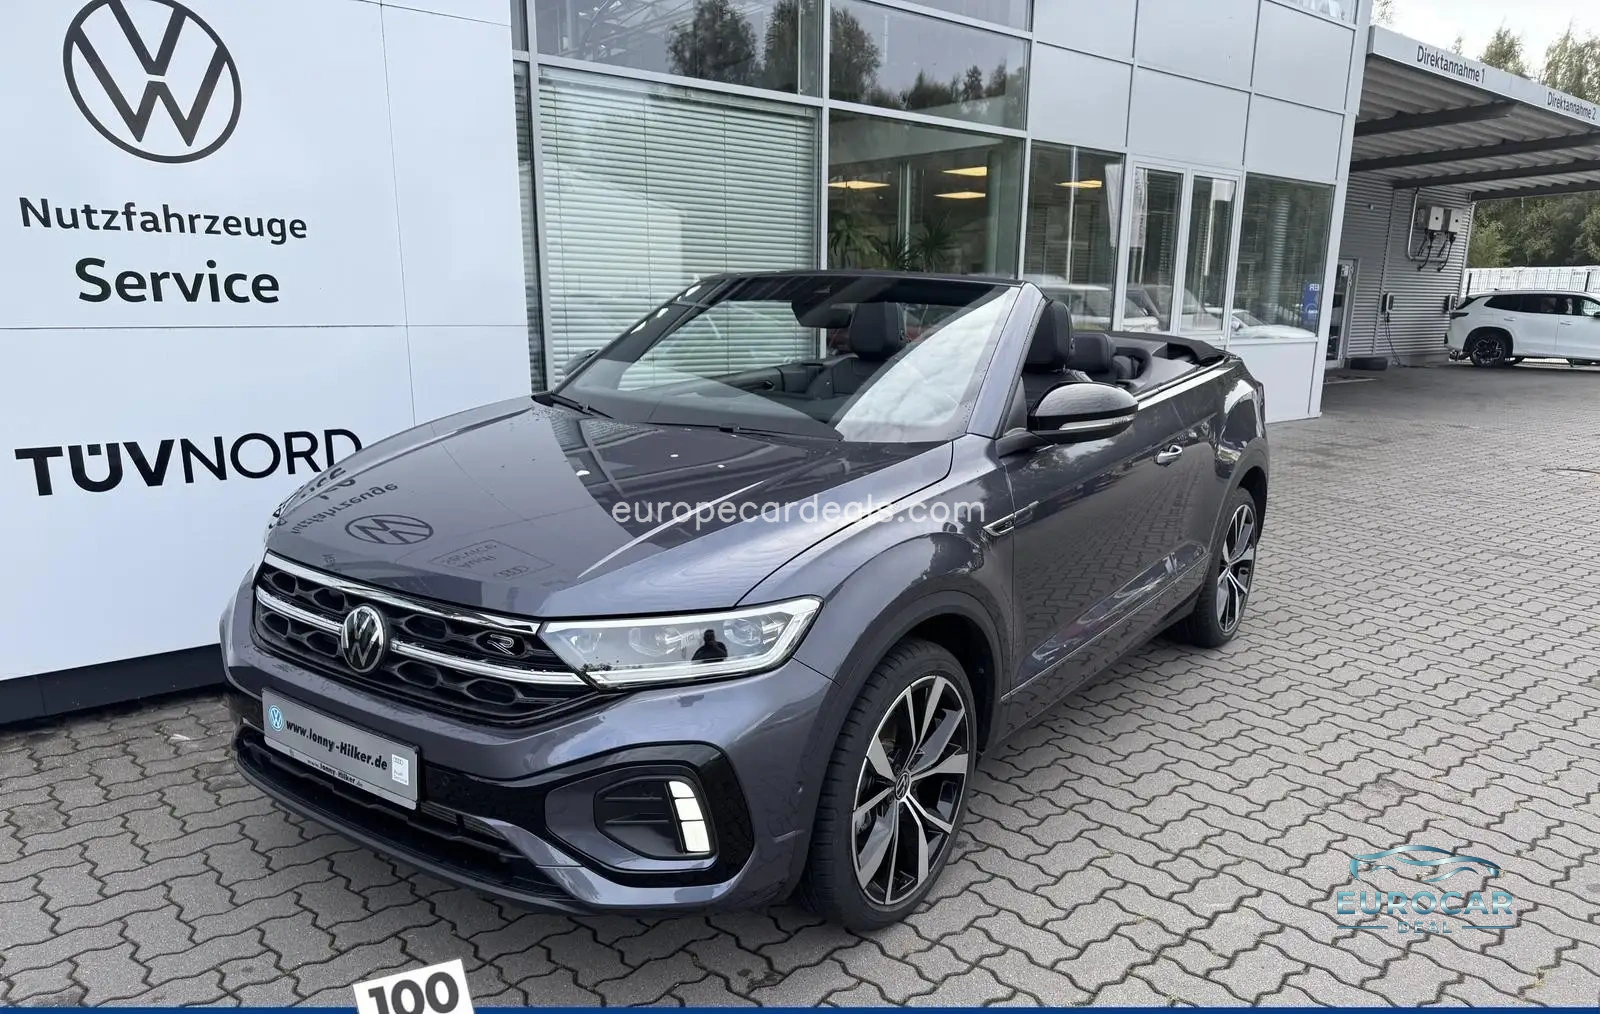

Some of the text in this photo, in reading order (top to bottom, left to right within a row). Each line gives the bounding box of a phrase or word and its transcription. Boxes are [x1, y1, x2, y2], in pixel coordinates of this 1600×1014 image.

[1416, 45, 1486, 84] Direktannahme 1
[1547, 91, 1597, 121] Direktannahme 2
[20, 197, 307, 246] Nutzfahrzeuge
[76, 258, 280, 303] Service
